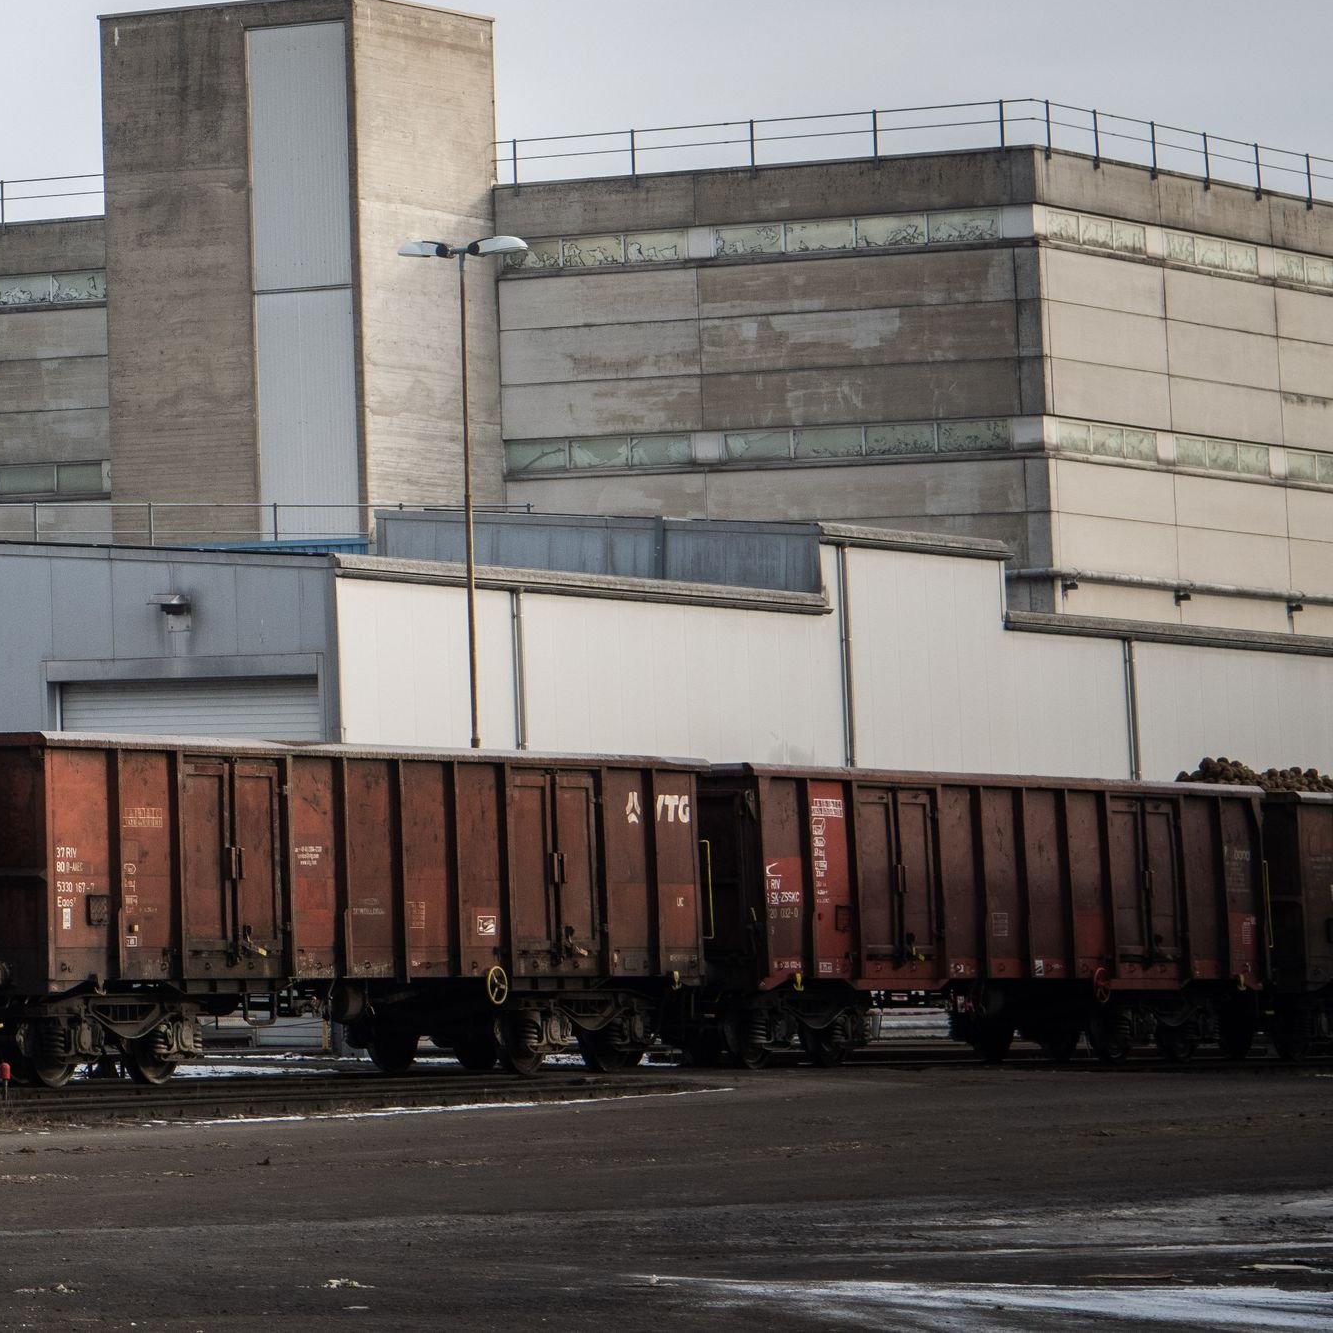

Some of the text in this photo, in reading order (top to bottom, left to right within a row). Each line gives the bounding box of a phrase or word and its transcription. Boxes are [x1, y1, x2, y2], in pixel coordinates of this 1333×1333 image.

[56, 847, 65, 858] 37
[56, 861, 66, 872] 80
[56, 881, 73, 893] 5330
